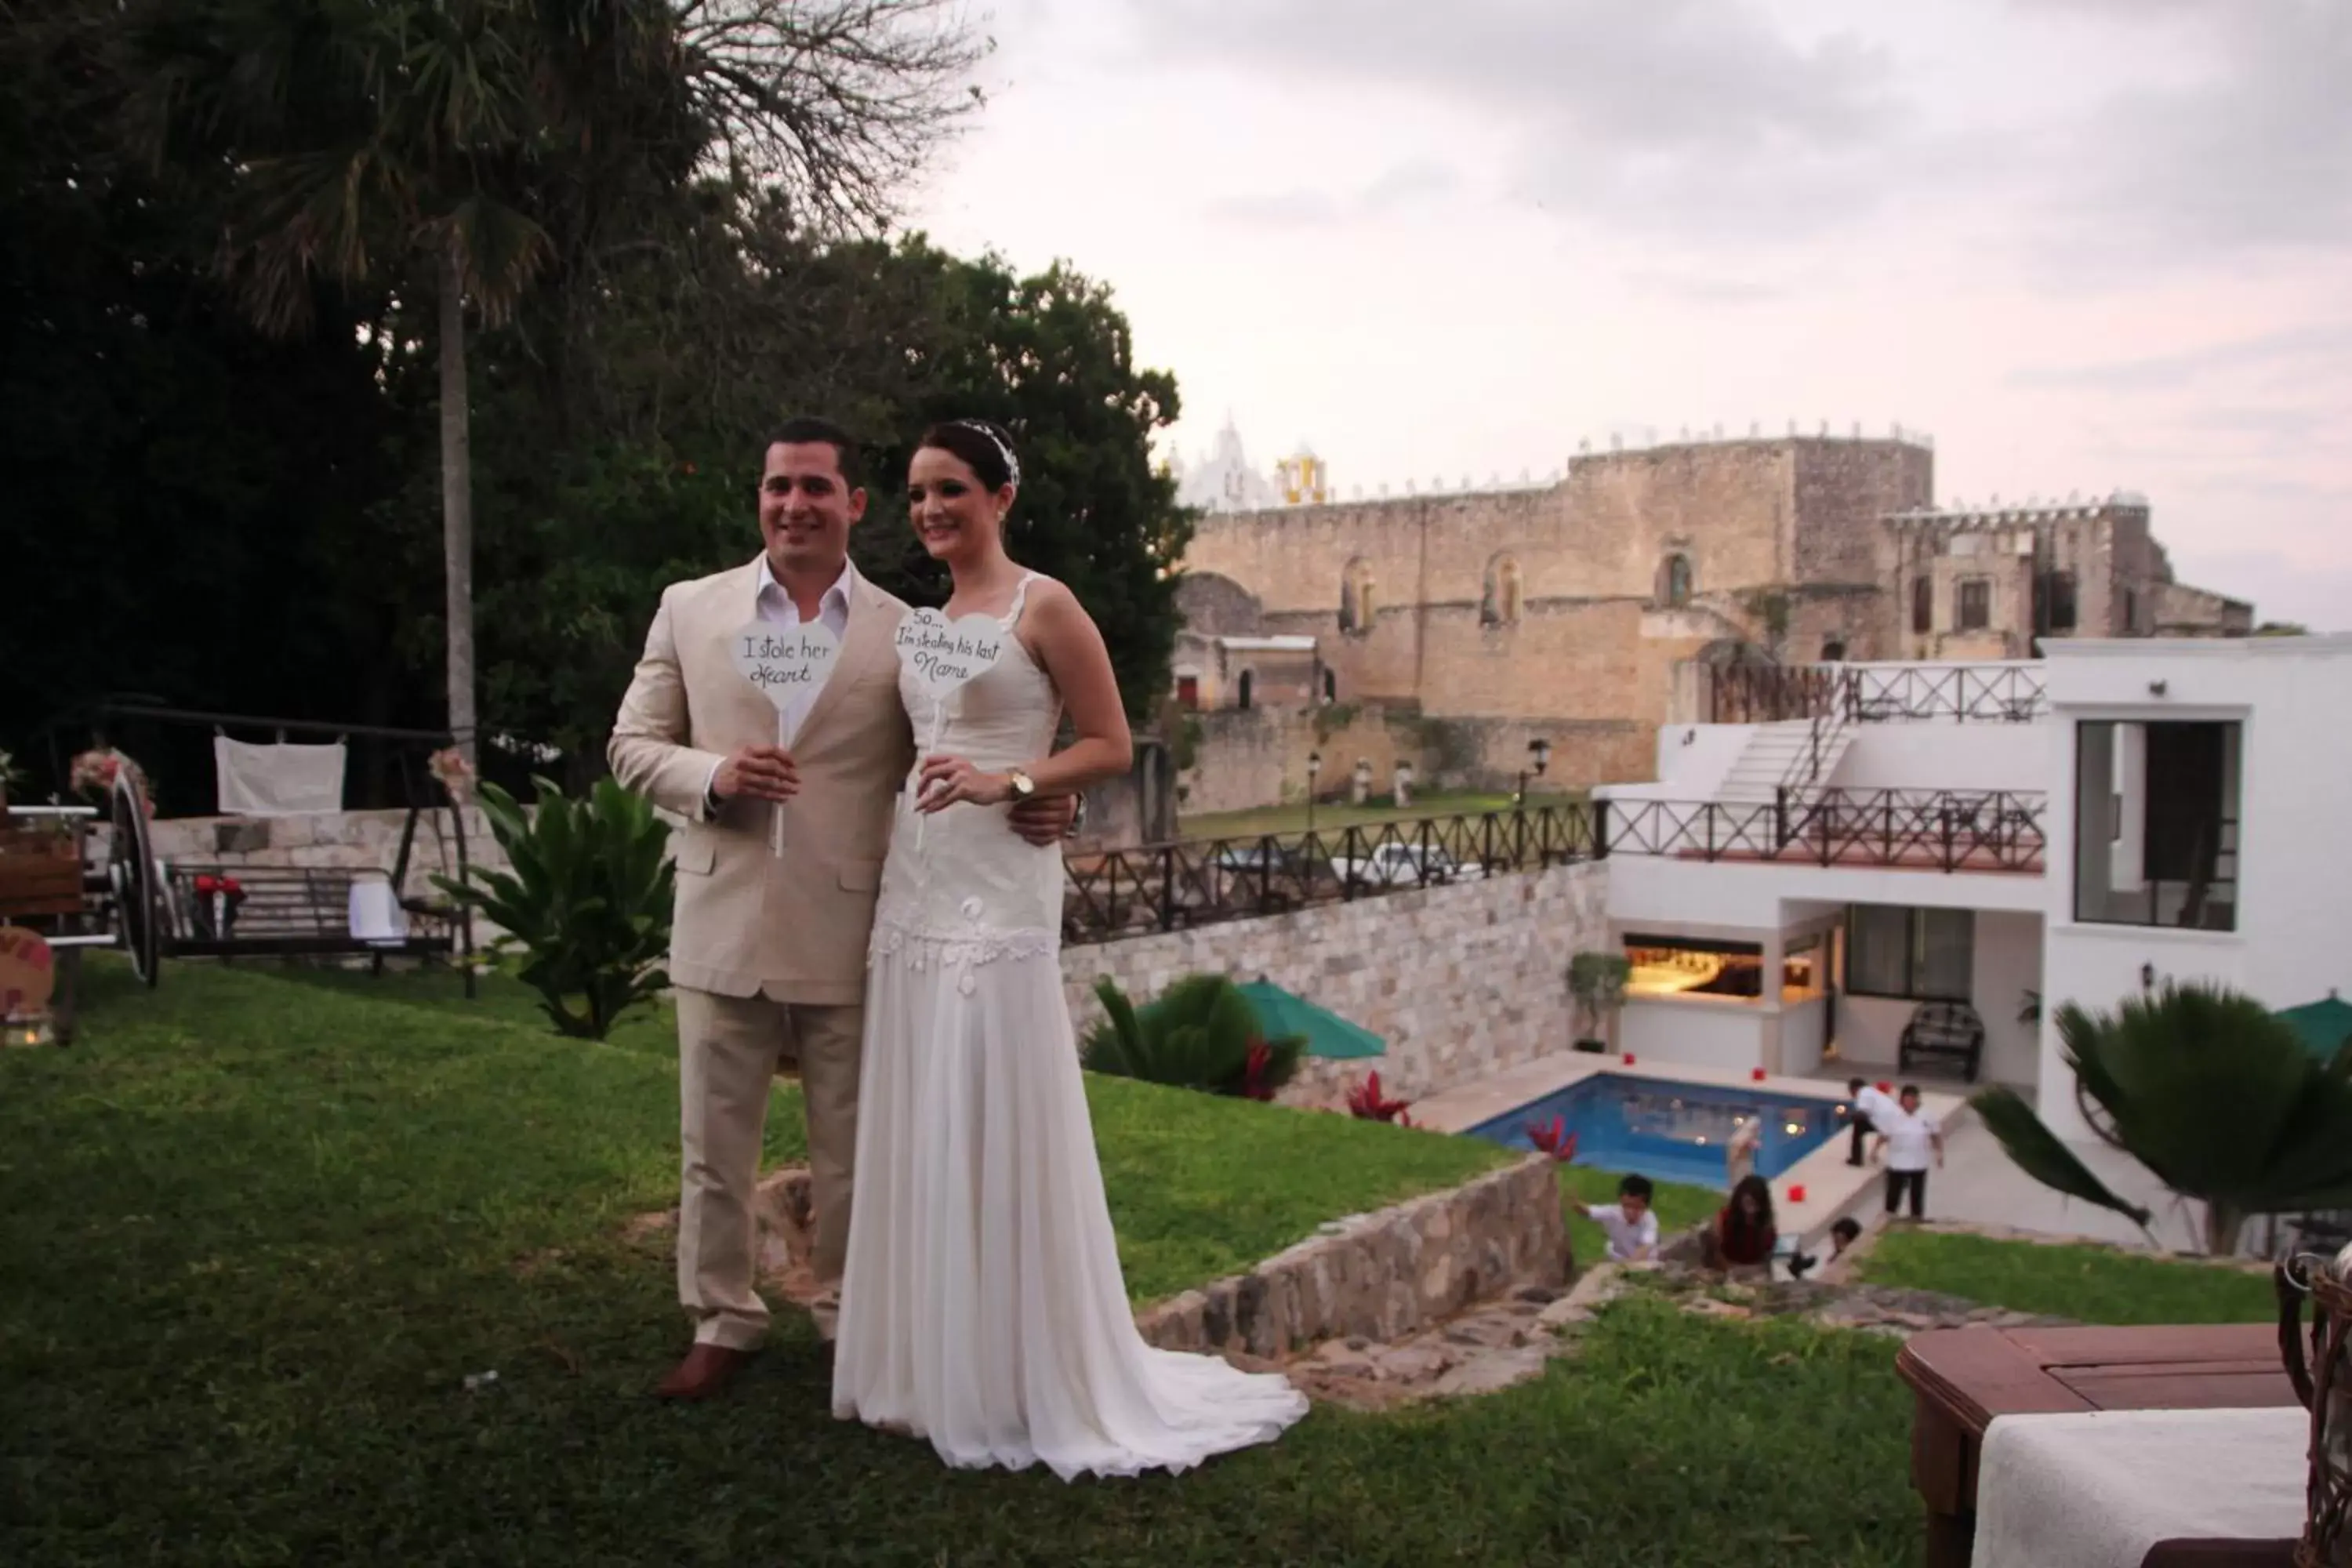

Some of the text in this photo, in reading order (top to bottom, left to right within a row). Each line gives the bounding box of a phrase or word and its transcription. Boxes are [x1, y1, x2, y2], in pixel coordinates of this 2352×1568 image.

[743, 634, 830, 659] I stole her
[956, 634, 973, 656] his
[976, 638, 1001, 662] last
[913, 651, 968, 683] Name
